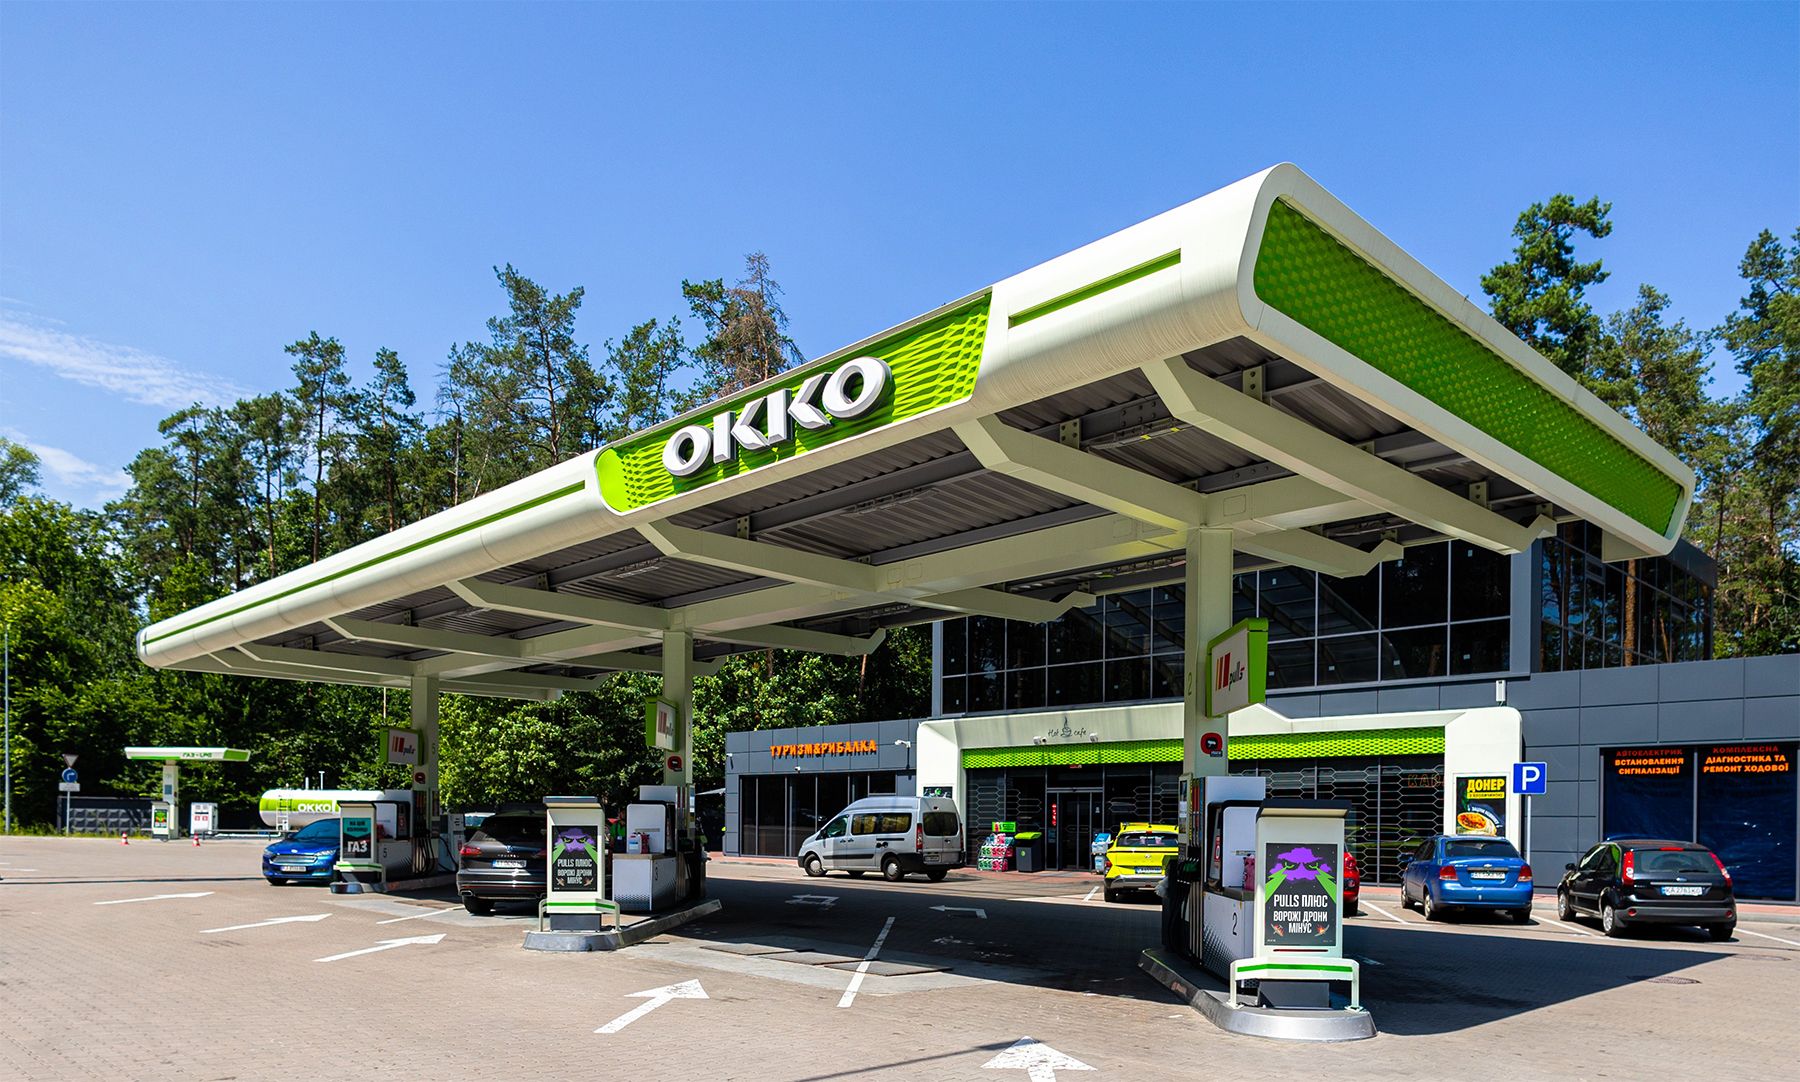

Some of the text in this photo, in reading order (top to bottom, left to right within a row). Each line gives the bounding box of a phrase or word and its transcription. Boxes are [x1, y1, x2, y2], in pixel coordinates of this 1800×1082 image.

[662, 356, 892, 477] OKKO
[1228, 661, 1245, 691] pulls
[1048, 727, 1087, 738] Hot cafe
[769, 739, 877, 758] ТУРИЗМ&РИБАЛКА
[1616, 749, 1683, 757] АВТОЕЛЕКТРИК
[1713, 745, 1779, 754] КОМПЛЕКСНА
[1614, 757, 1684, 766] ВСТАНОВЛЕННЯ
[1705, 754, 1786, 765] ДІАГНОСТИКА ТА
[1618, 765, 1680, 775] СИГНАЛІЗАЦІЇ
[1703, 762, 1789, 773] РЕМОНТ ХОДОВОЇ
[1522, 767, 1540, 791] P
[1467, 778, 1505, 793] ДОНЕР
[298, 803, 331, 813] OKKO
[347, 841, 368, 853] ГАЗ
[383, 848, 388, 858] 5
[557, 858, 592, 867] PULLS ПЛЮС
[1273, 894, 1328, 907] PULLS ПЛЮС
[1273, 911, 1328, 923] ВОРОЖІ ДРОНИ
[1232, 912, 1238, 936] 2
[1288, 922, 1312, 933] МІНУС
